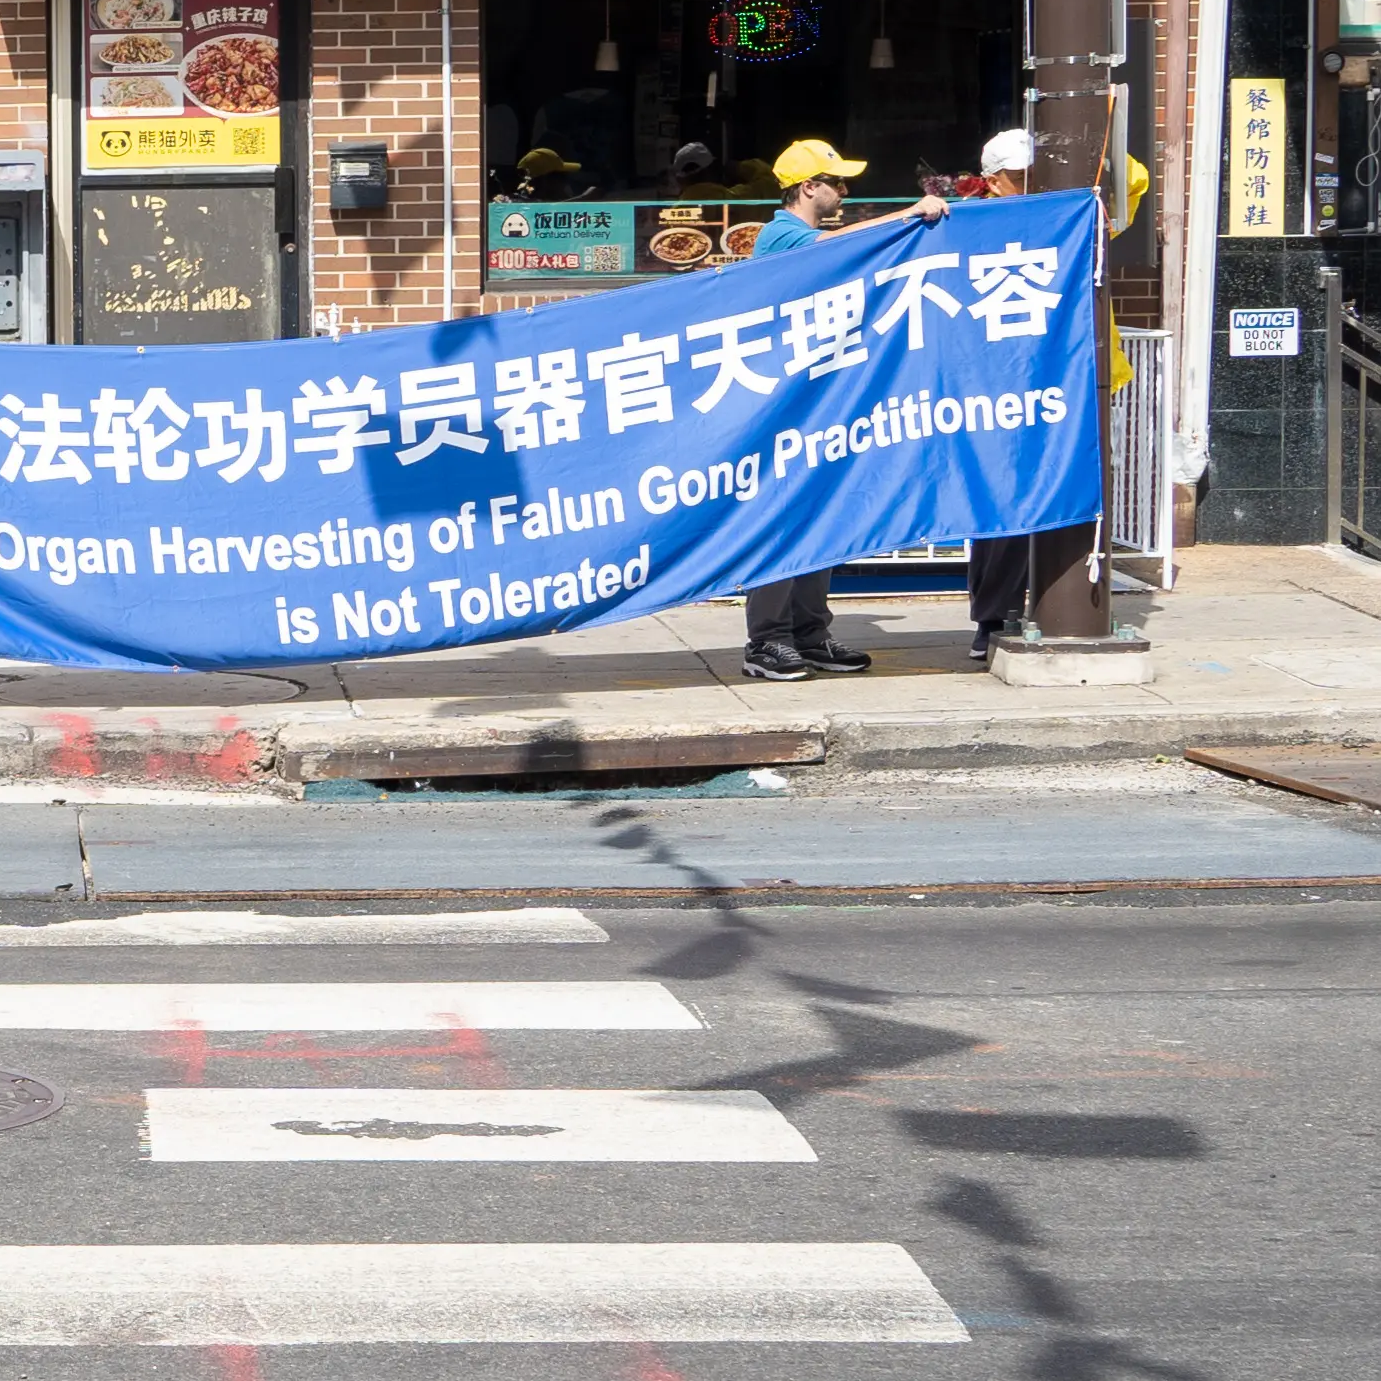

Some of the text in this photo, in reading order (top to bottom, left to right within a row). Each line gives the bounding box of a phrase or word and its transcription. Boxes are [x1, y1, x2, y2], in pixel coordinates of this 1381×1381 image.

[190, 6, 269, 30] 重庆辣子鸡
[708, 6, 823, 48] OPEN
[138, 129, 216, 148] 熊猫外卖
[1242, 88, 1273, 227] 餐館防滑鞋
[534, 211, 612, 229] 饭团外卖
[534, 230, 611, 240] Fantuan Delivery
[1235, 312, 1295, 328] NOTICE
[1243, 328, 1286, 341] DO NOT
[1244, 340, 1284, 351] BLOCK
[149, 515, 415, 577] Harvesting
[427, 502, 477, 555] of
[489, 485, 626, 547] Falun
[637, 451, 761, 515] Gong
[773, 382, 1068, 480] Practitioners
[274, 544, 651, 645] is Not Tolerated
